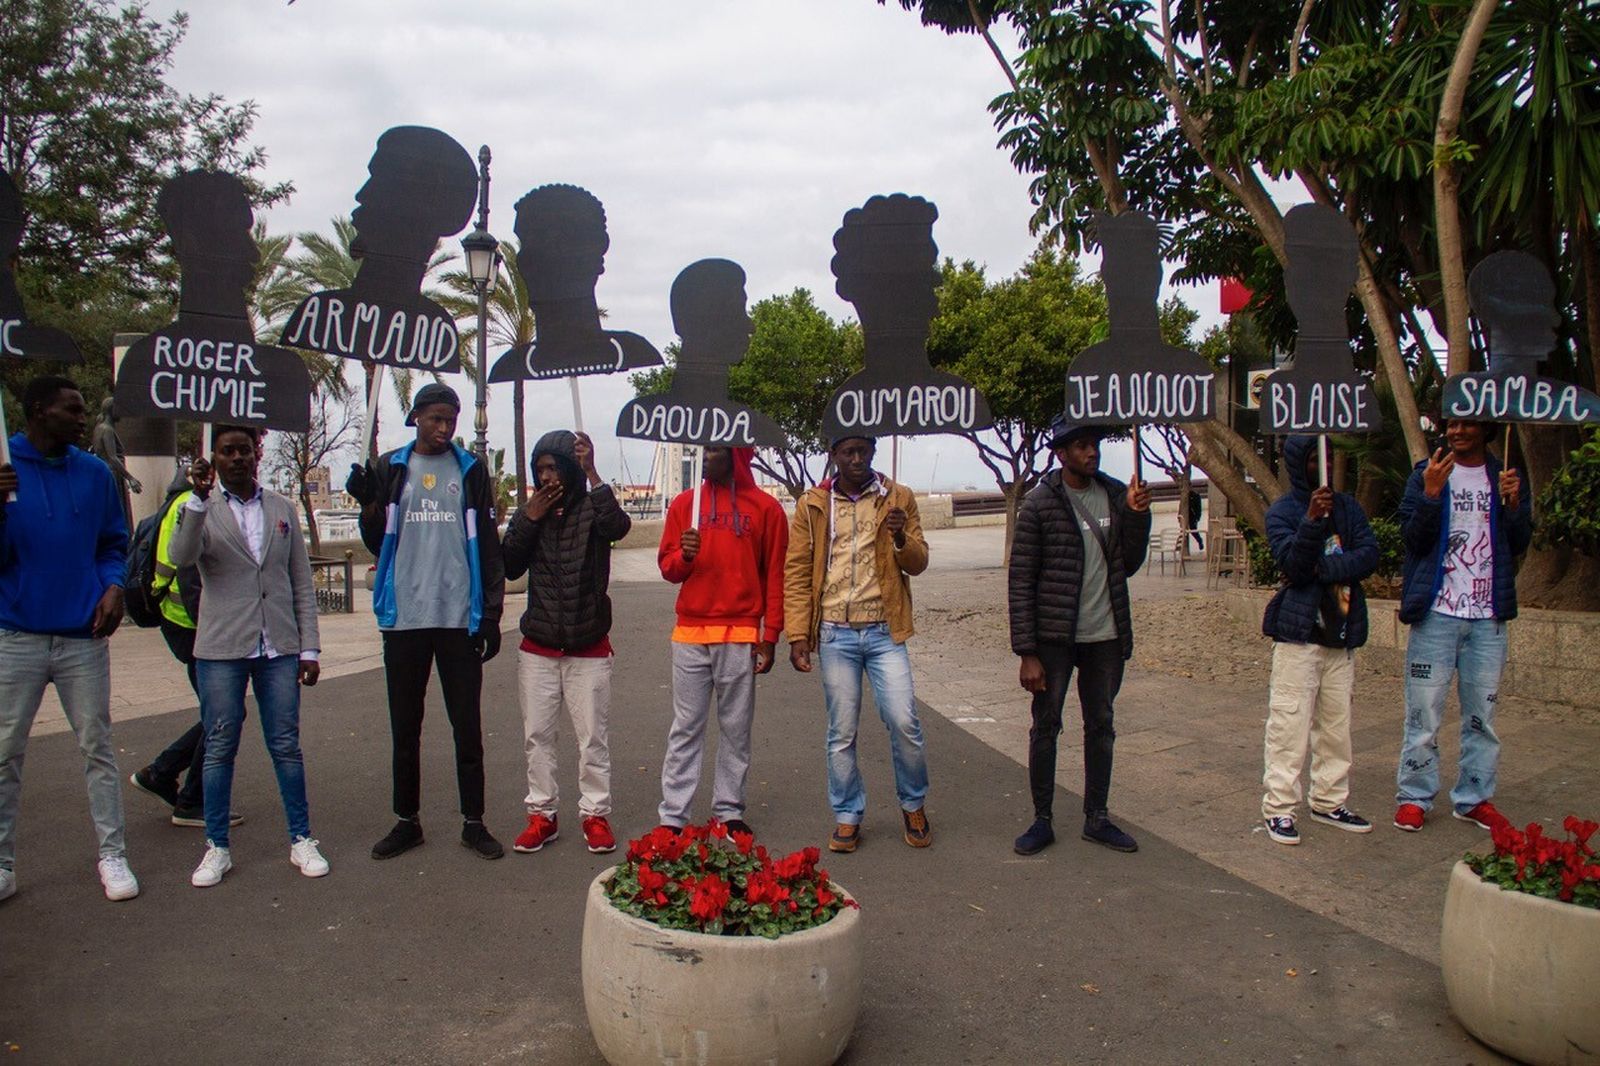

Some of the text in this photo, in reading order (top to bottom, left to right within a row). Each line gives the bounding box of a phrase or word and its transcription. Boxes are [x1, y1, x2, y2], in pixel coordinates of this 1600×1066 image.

[0, 319, 29, 356] C
[287, 296, 459, 368] ARMAND
[154, 336, 261, 376] ROGER
[150, 371, 266, 419] CHIMIE
[836, 385, 976, 429] OUMAROU
[1069, 373, 1214, 420] JEANNOT
[1270, 382, 1368, 428] BLAISE
[1451, 376, 1589, 422] SAMBA
[632, 403, 755, 444] DAOUDA
[405, 508, 457, 522] Emirates
